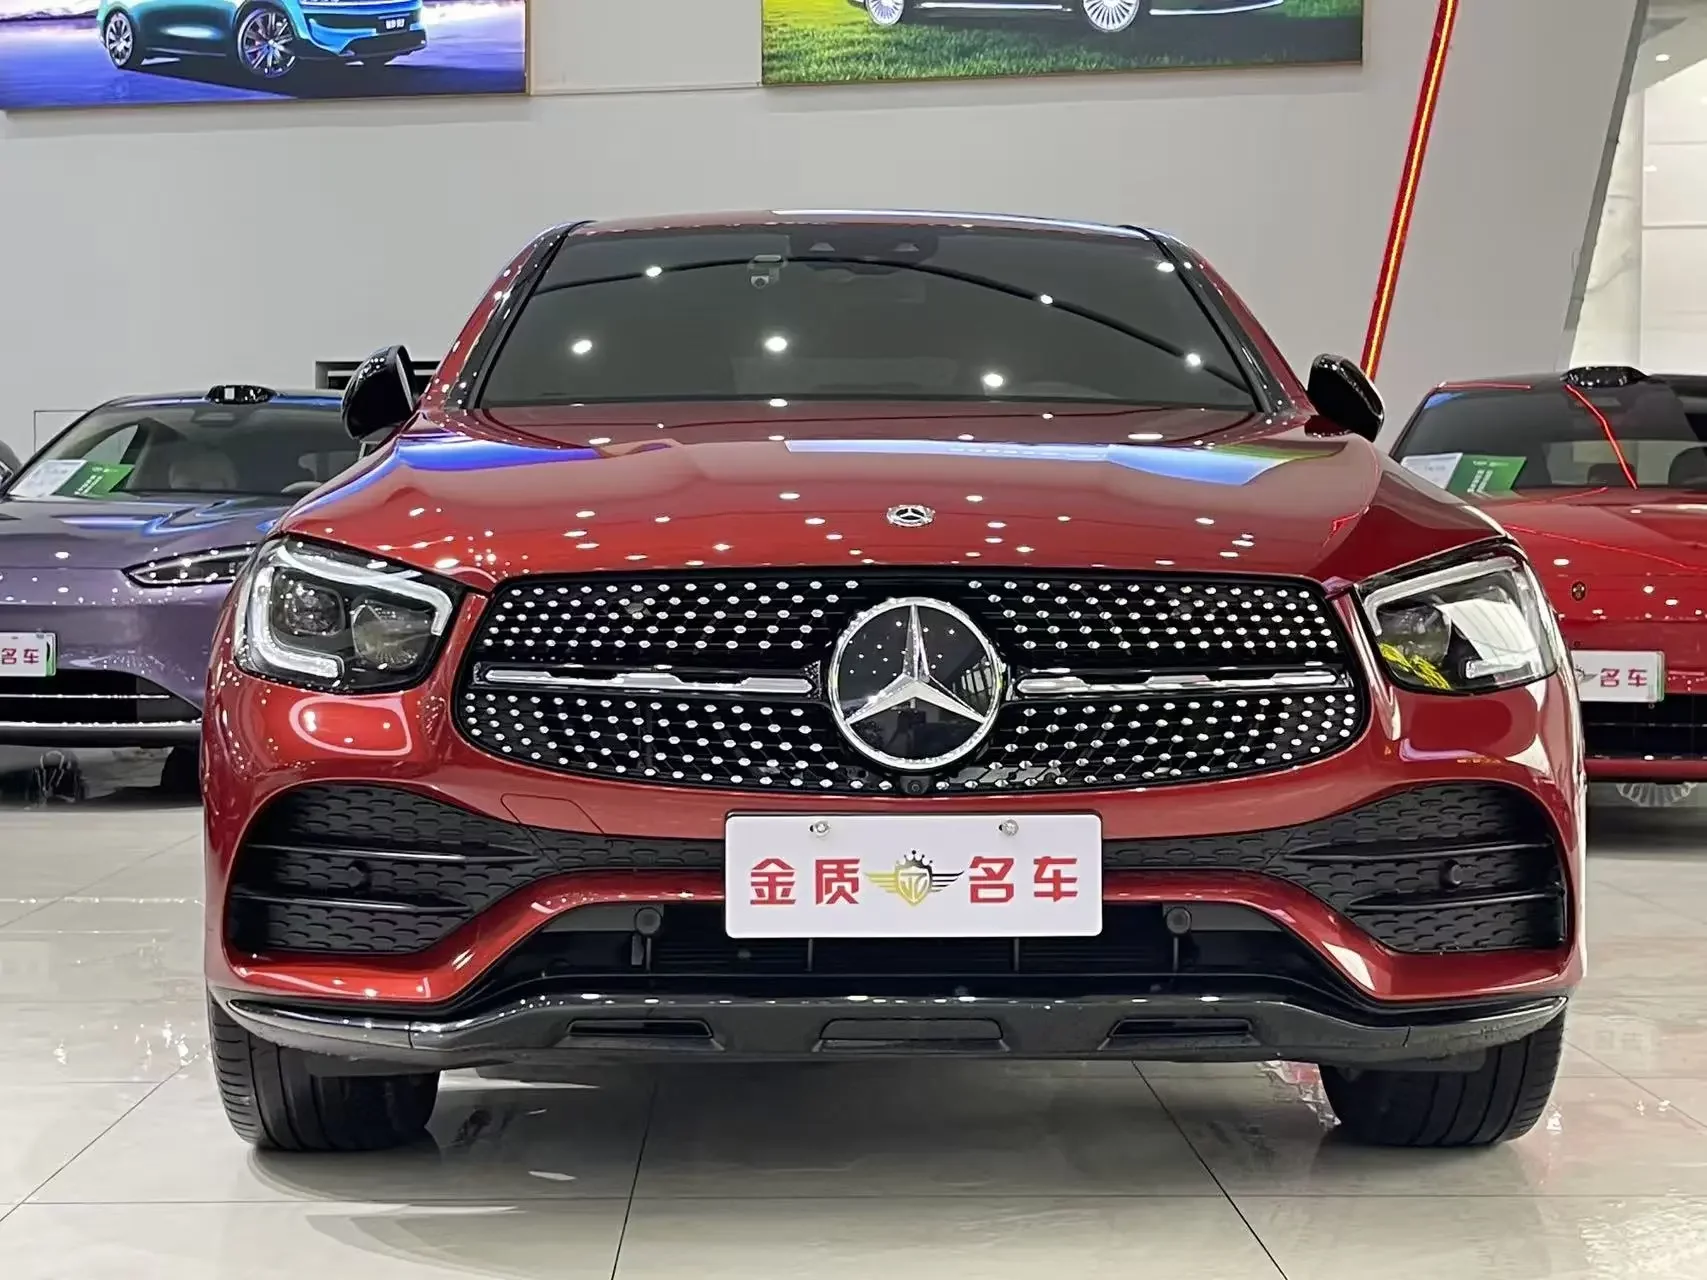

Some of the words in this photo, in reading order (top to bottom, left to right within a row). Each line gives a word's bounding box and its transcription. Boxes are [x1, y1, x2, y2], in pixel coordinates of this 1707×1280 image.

[2, 648, 39, 665] 名车
[1601, 668, 1647, 687] 名车
[750, 857, 860, 905] 金质
[969, 855, 1078, 903] 名车
